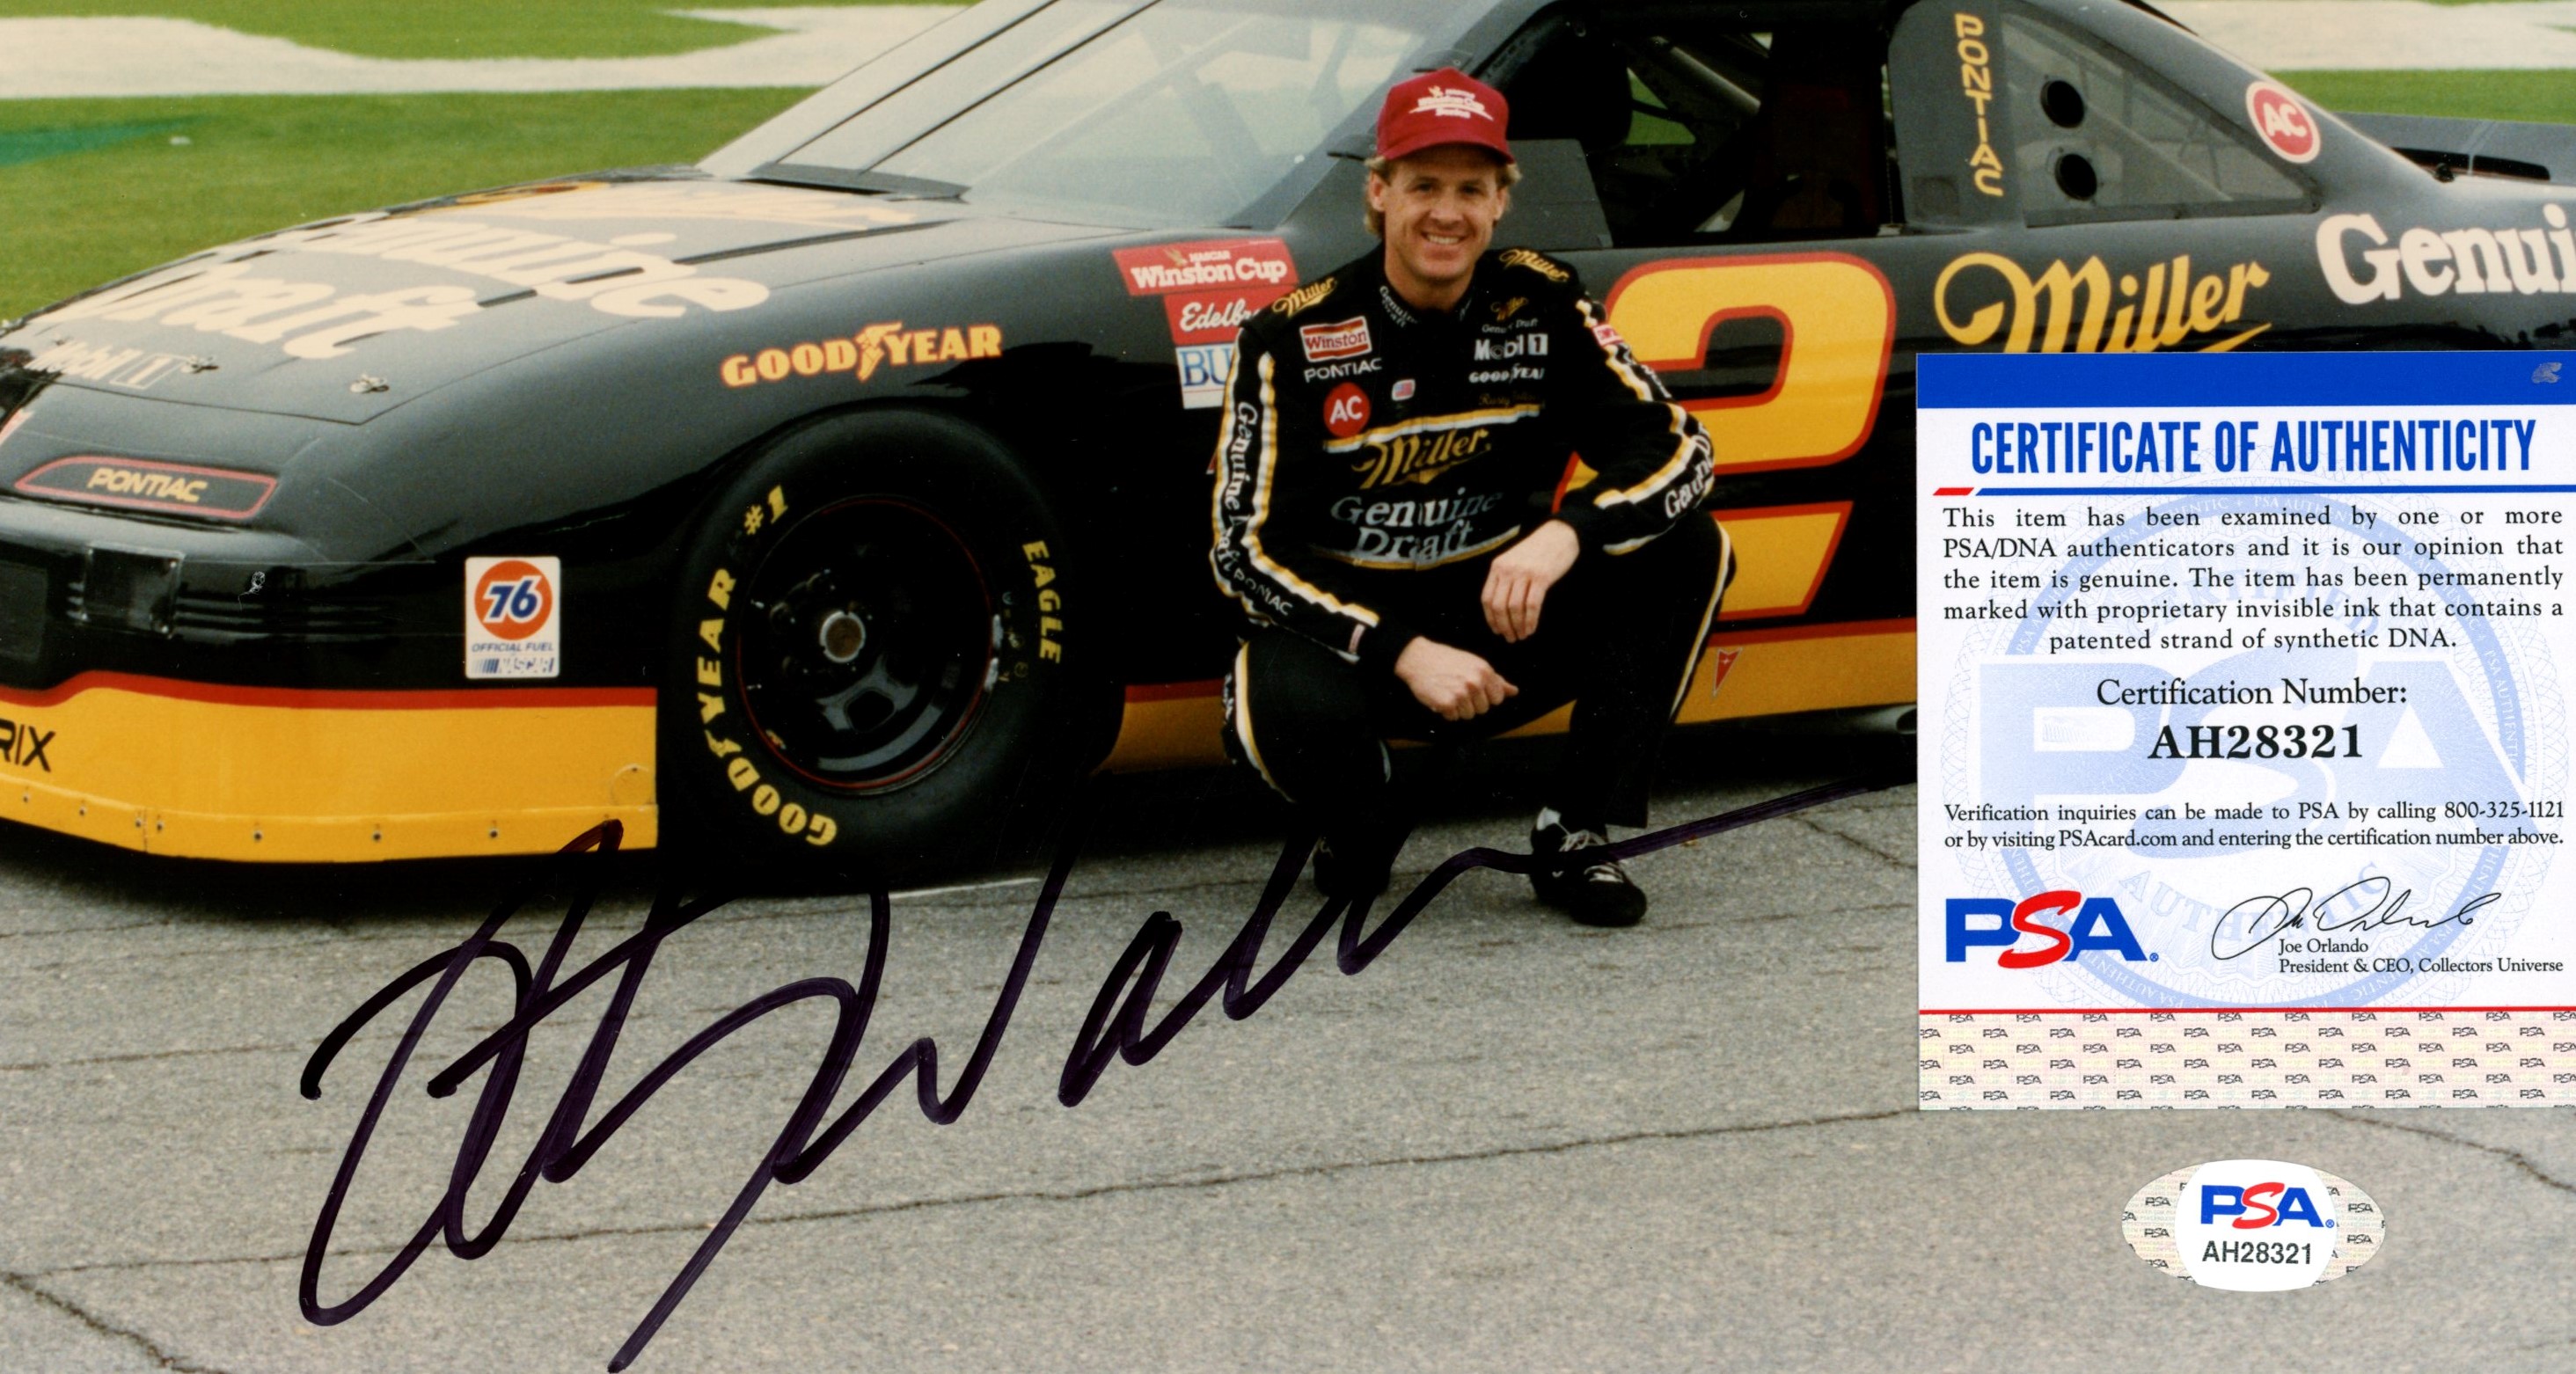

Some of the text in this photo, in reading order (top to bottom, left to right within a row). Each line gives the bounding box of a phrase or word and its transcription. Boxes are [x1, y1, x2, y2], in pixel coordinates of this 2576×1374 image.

[1954, 12, 2004, 198] PONTIAC
[2264, 100, 2308, 140] AC
[1130, 258, 1288, 289] Winston Cup
[1271, 276, 1336, 319] Miller
[1934, 252, 2272, 353] Miller
[1179, 298, 1261, 333] Edelbr
[721, 322, 1003, 388] GOODYEAR
[1305, 330, 1367, 351] Winston
[1303, 357, 1383, 384] PONTIAC
[1329, 396, 1363, 425] AC
[1551, 251, 1897, 621] 2
[1972, 420, 2536, 474] CERTIFICATE OF AUTHENTICITY
[1225, 401, 1258, 511] Genuine
[1350, 428, 1493, 490] Miller
[87, 466, 209, 503] PONTIAC
[1330, 486, 1506, 528] Genuine
[1943, 504, 2562, 530] This item has been examined by one or more
[1355, 519, 1474, 560] Draft
[1943, 534, 2564, 560] PSA/DNA authenticators and it is our opinion that
[1943, 565, 2563, 593] the item is genuine. The item has been permanently
[483, 574, 543, 624] 76
[1021, 539, 1064, 664] EAGLE
[1943, 596, 2563, 624] marked with proprietary invisible ink that contains a
[471, 641, 553, 653] OFFICIAL FUEL
[2049, 627, 2456, 654] patented strand of synthetic DNA.
[696, 484, 838, 847] GOODYEAR #1
[2097, 676, 2407, 705] Certification Number:
[2147, 724, 2363, 760] AH28321
[1944, 800, 2564, 825] Verification inquiries can be made to PSA by calling 800-325-1121
[1944, 826, 2564, 851] or by visiting PSAcard.com and entering the certification number above.
[2278, 938, 2368, 956] Joe Orlando
[2280, 957, 2564, 974] President & CEO, Collectors Universe
[2201, 1240, 2312, 1265] AH28321
